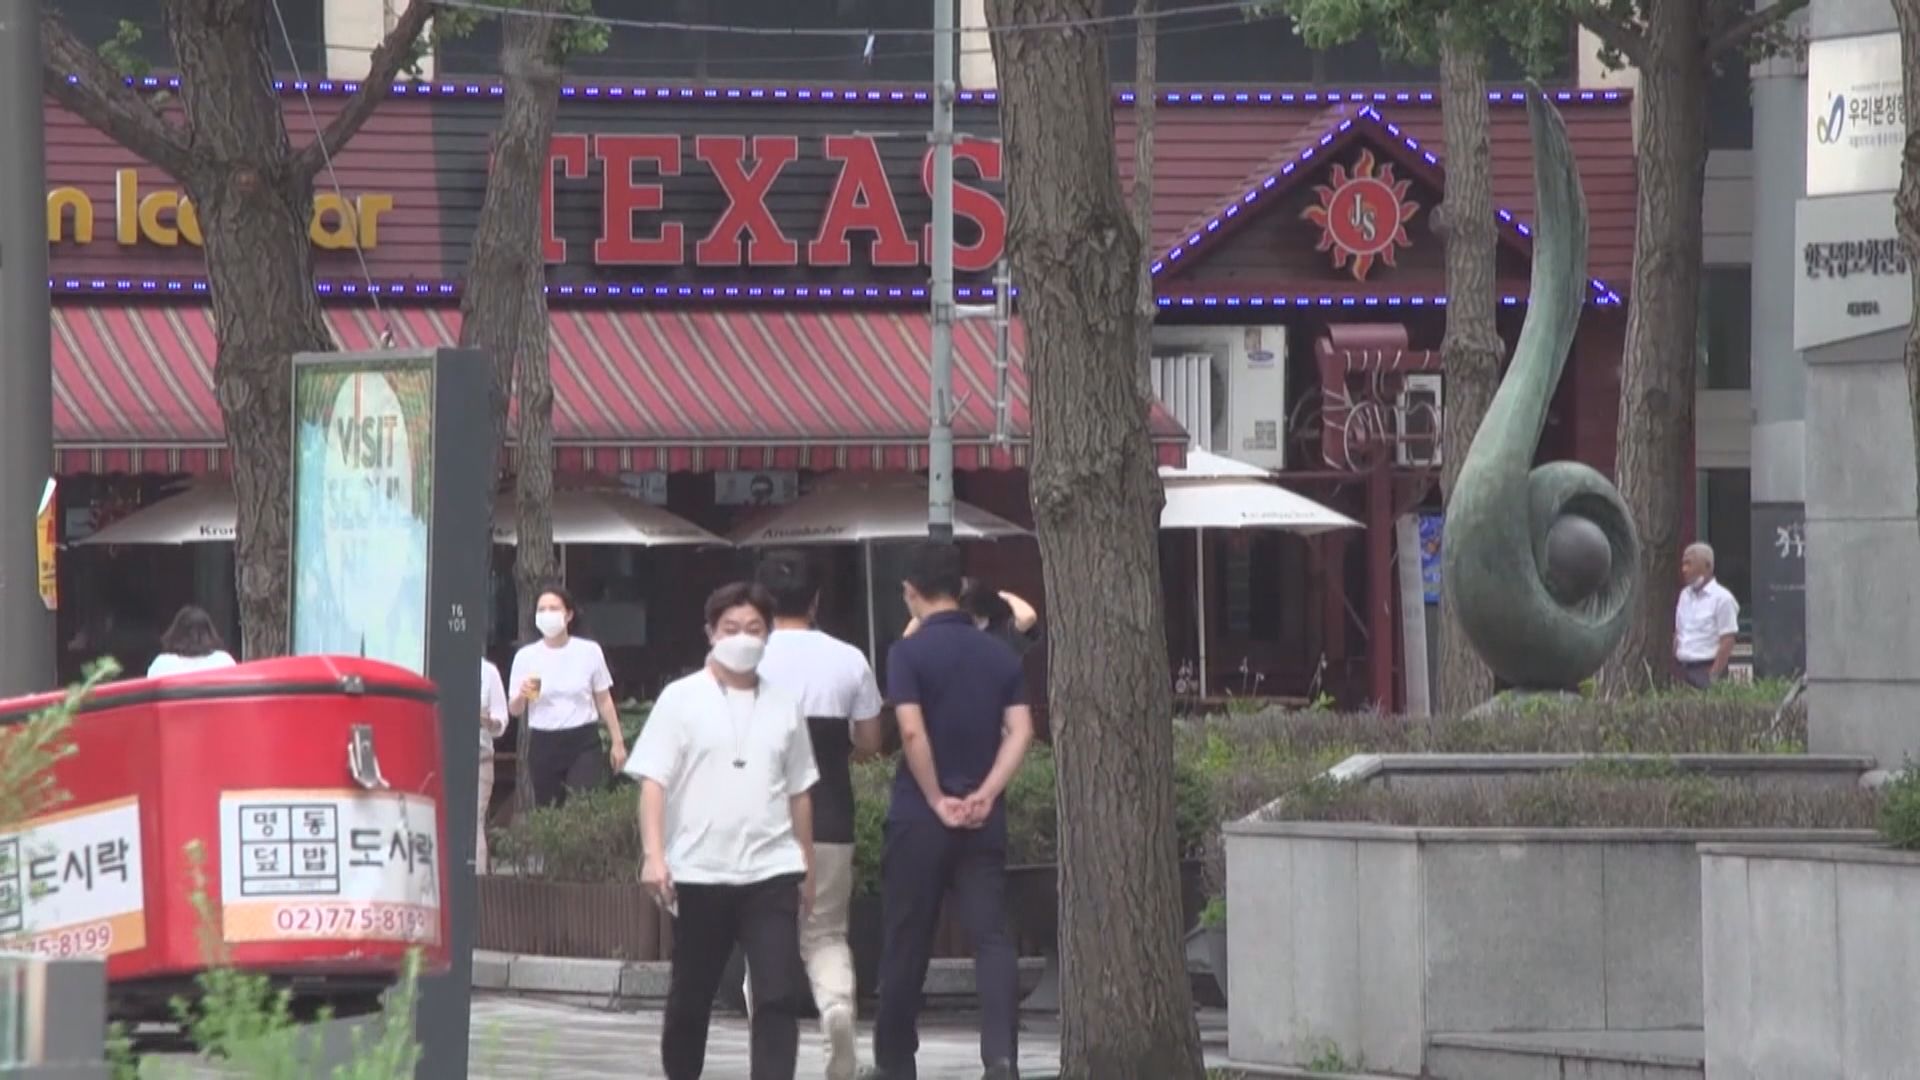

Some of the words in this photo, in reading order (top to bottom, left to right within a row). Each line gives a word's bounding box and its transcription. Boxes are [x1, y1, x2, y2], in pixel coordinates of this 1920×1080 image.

[541, 133, 1007, 272] TEXAS
[336, 415, 398, 469] VISIT
[29, 837, 129, 898] 도시락
[349, 828, 433, 874] 도시락
